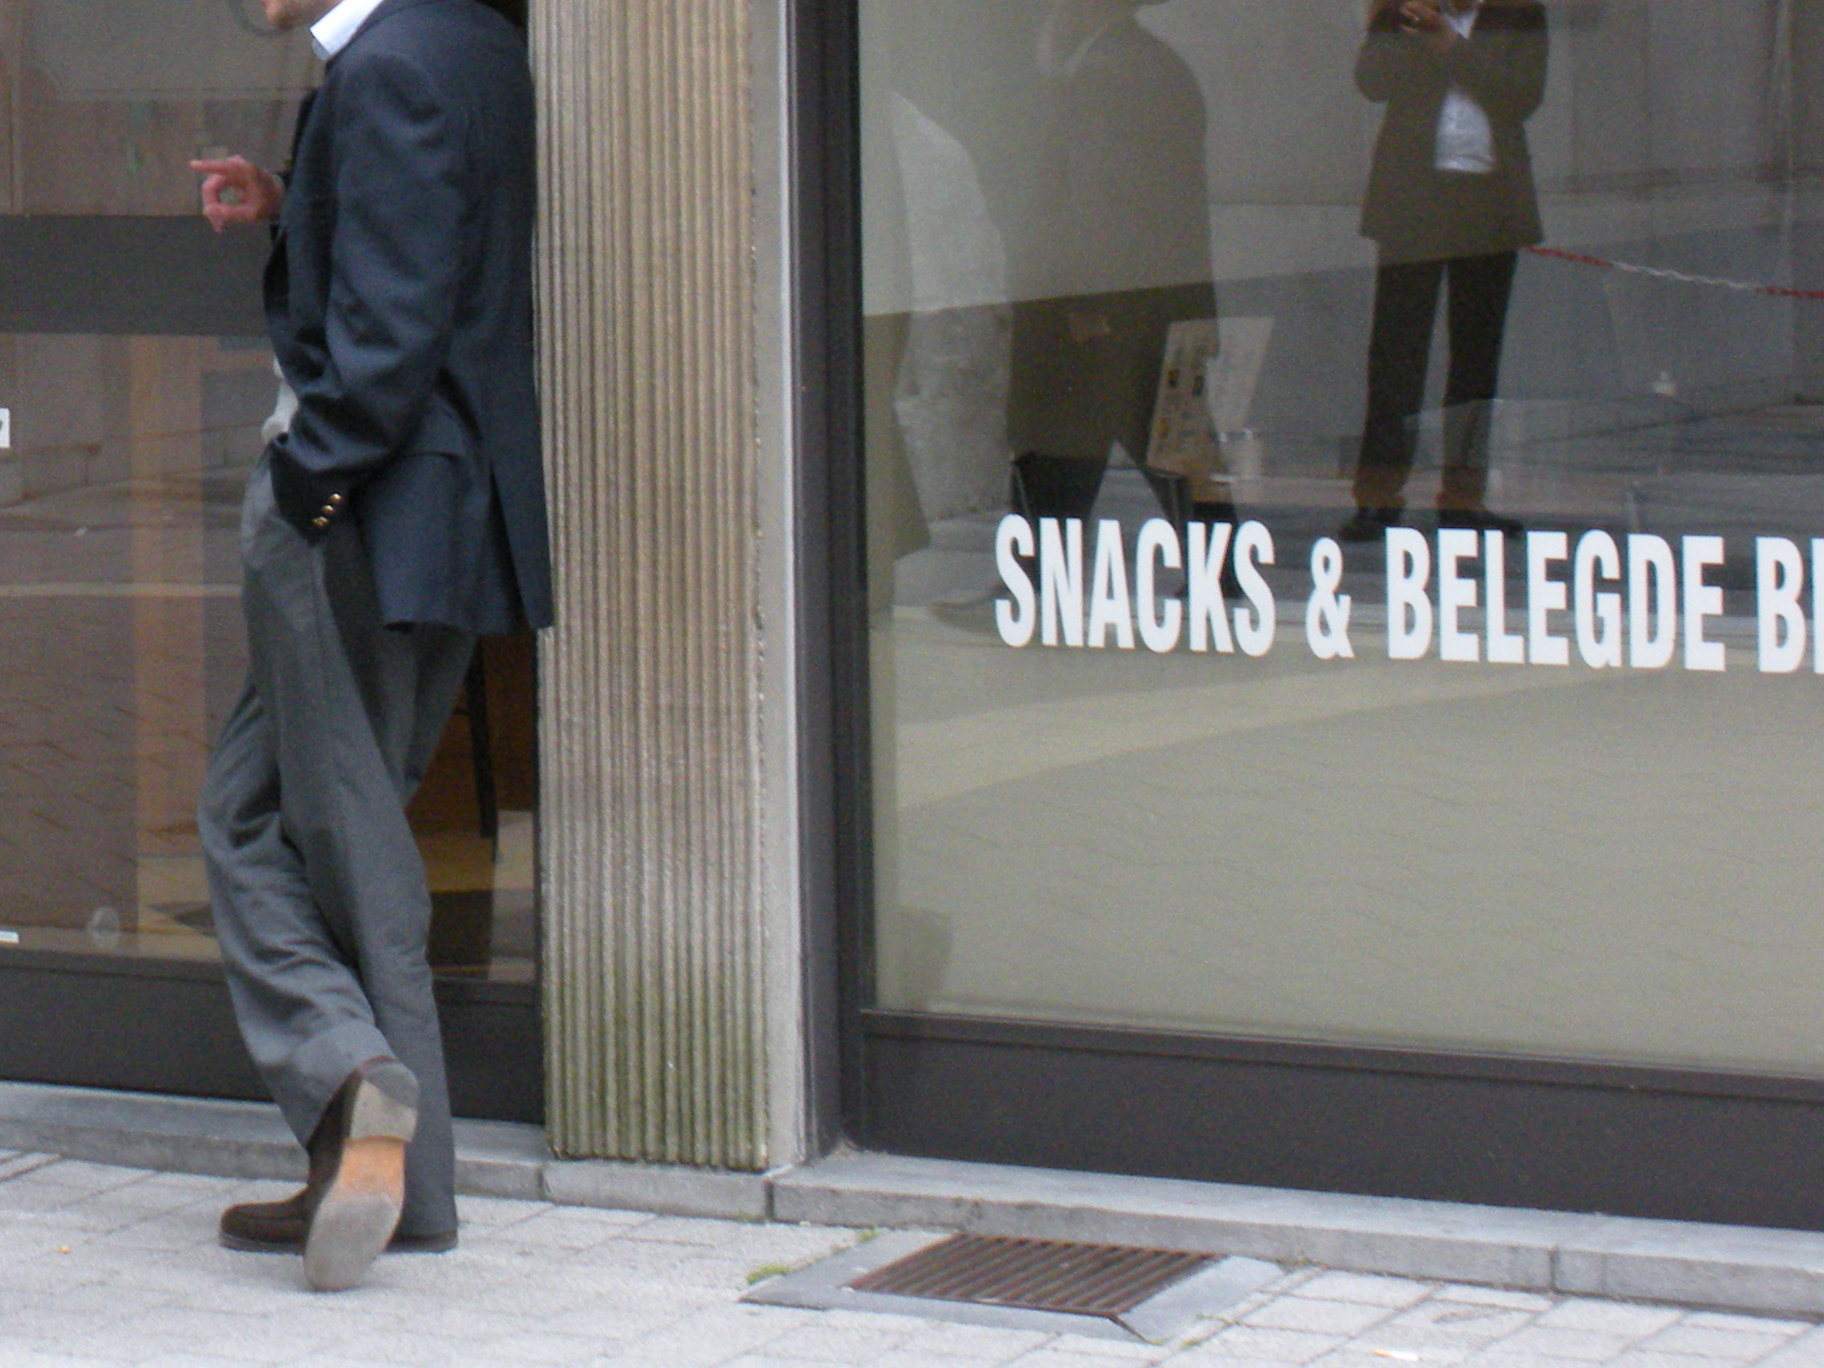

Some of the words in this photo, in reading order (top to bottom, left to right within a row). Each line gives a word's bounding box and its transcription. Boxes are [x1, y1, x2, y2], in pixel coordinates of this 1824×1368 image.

[994, 514, 1276, 657] SNACKS
[1306, 537, 1355, 659] &
[1386, 527, 1726, 671] BELEGDE
